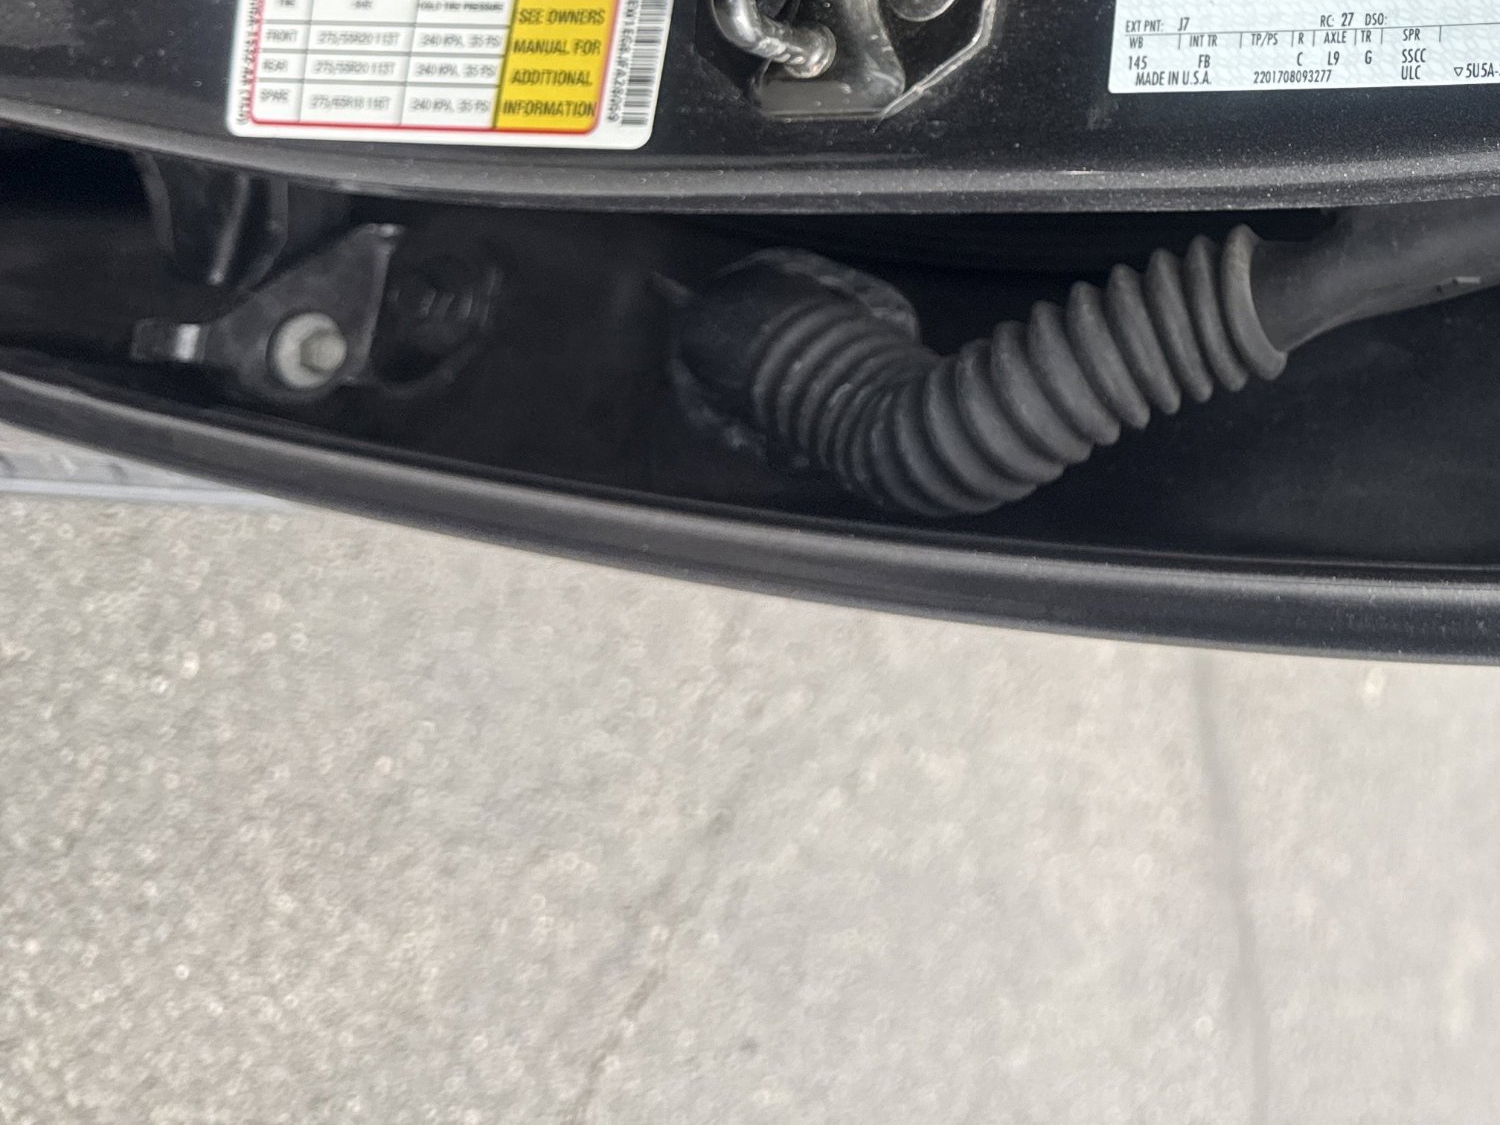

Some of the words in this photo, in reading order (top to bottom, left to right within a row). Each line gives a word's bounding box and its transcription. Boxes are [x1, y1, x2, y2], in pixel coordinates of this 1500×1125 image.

[516, 8, 544, 24] SEE
[545, 8, 605, 25] OWNERS
[512, 38, 569, 55] MANUAL
[572, 39, 601, 55] FOR
[1401, 47, 1426, 63] SSCC
[510, 69, 592, 86] ADDITIONAL
[1134, 71, 1165, 86] MADE
[1167, 70, 1179, 85] IN
[1181, 70, 1211, 85] U.S.A.
[1253, 68, 1332, 83] 2201708093277
[1400, 64, 1420, 80] ULC
[501, 99, 596, 118] INFORMATION
